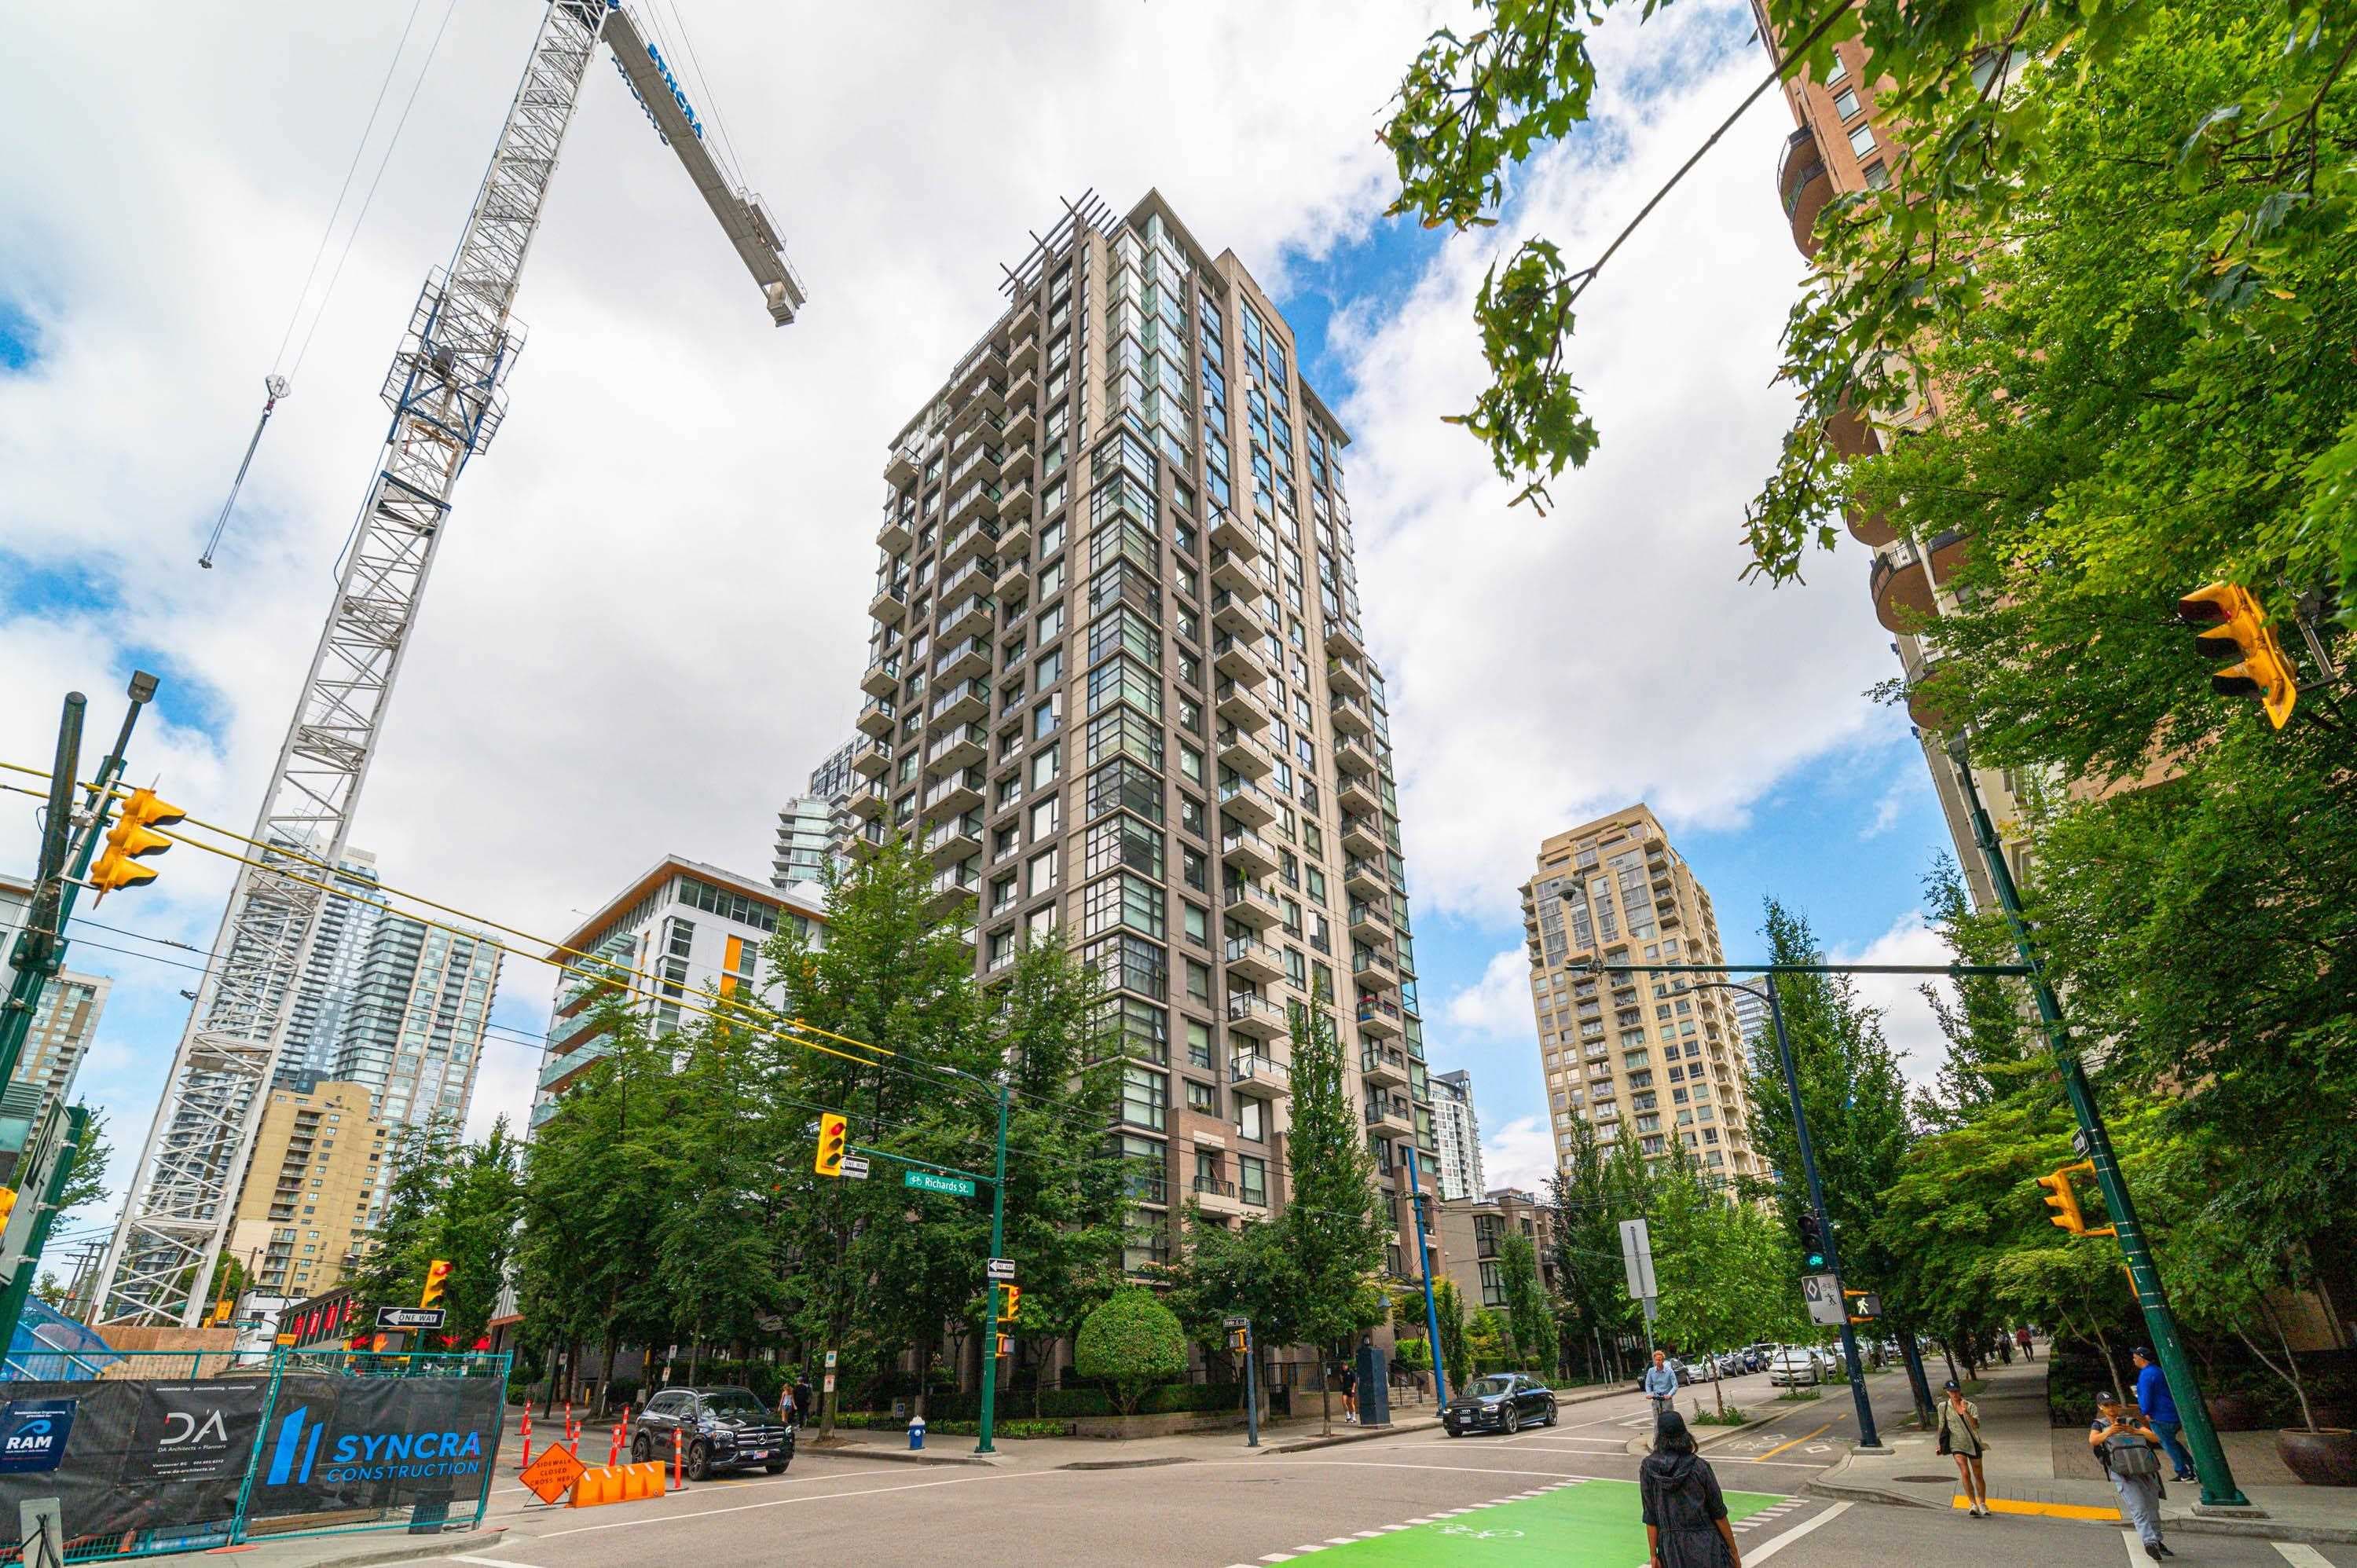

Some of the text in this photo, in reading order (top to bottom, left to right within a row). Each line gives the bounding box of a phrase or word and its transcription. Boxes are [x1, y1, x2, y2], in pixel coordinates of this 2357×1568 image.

[925, 1177, 969, 1193] Richards St.
[419, 1314, 435, 1323] WAY
[159, 1409, 228, 1445] DA
[6, 1436, 53, 1449] RAM
[333, 1431, 481, 1462] SYNCRA
[327, 1461, 479, 1482] CONSTRUCTION
